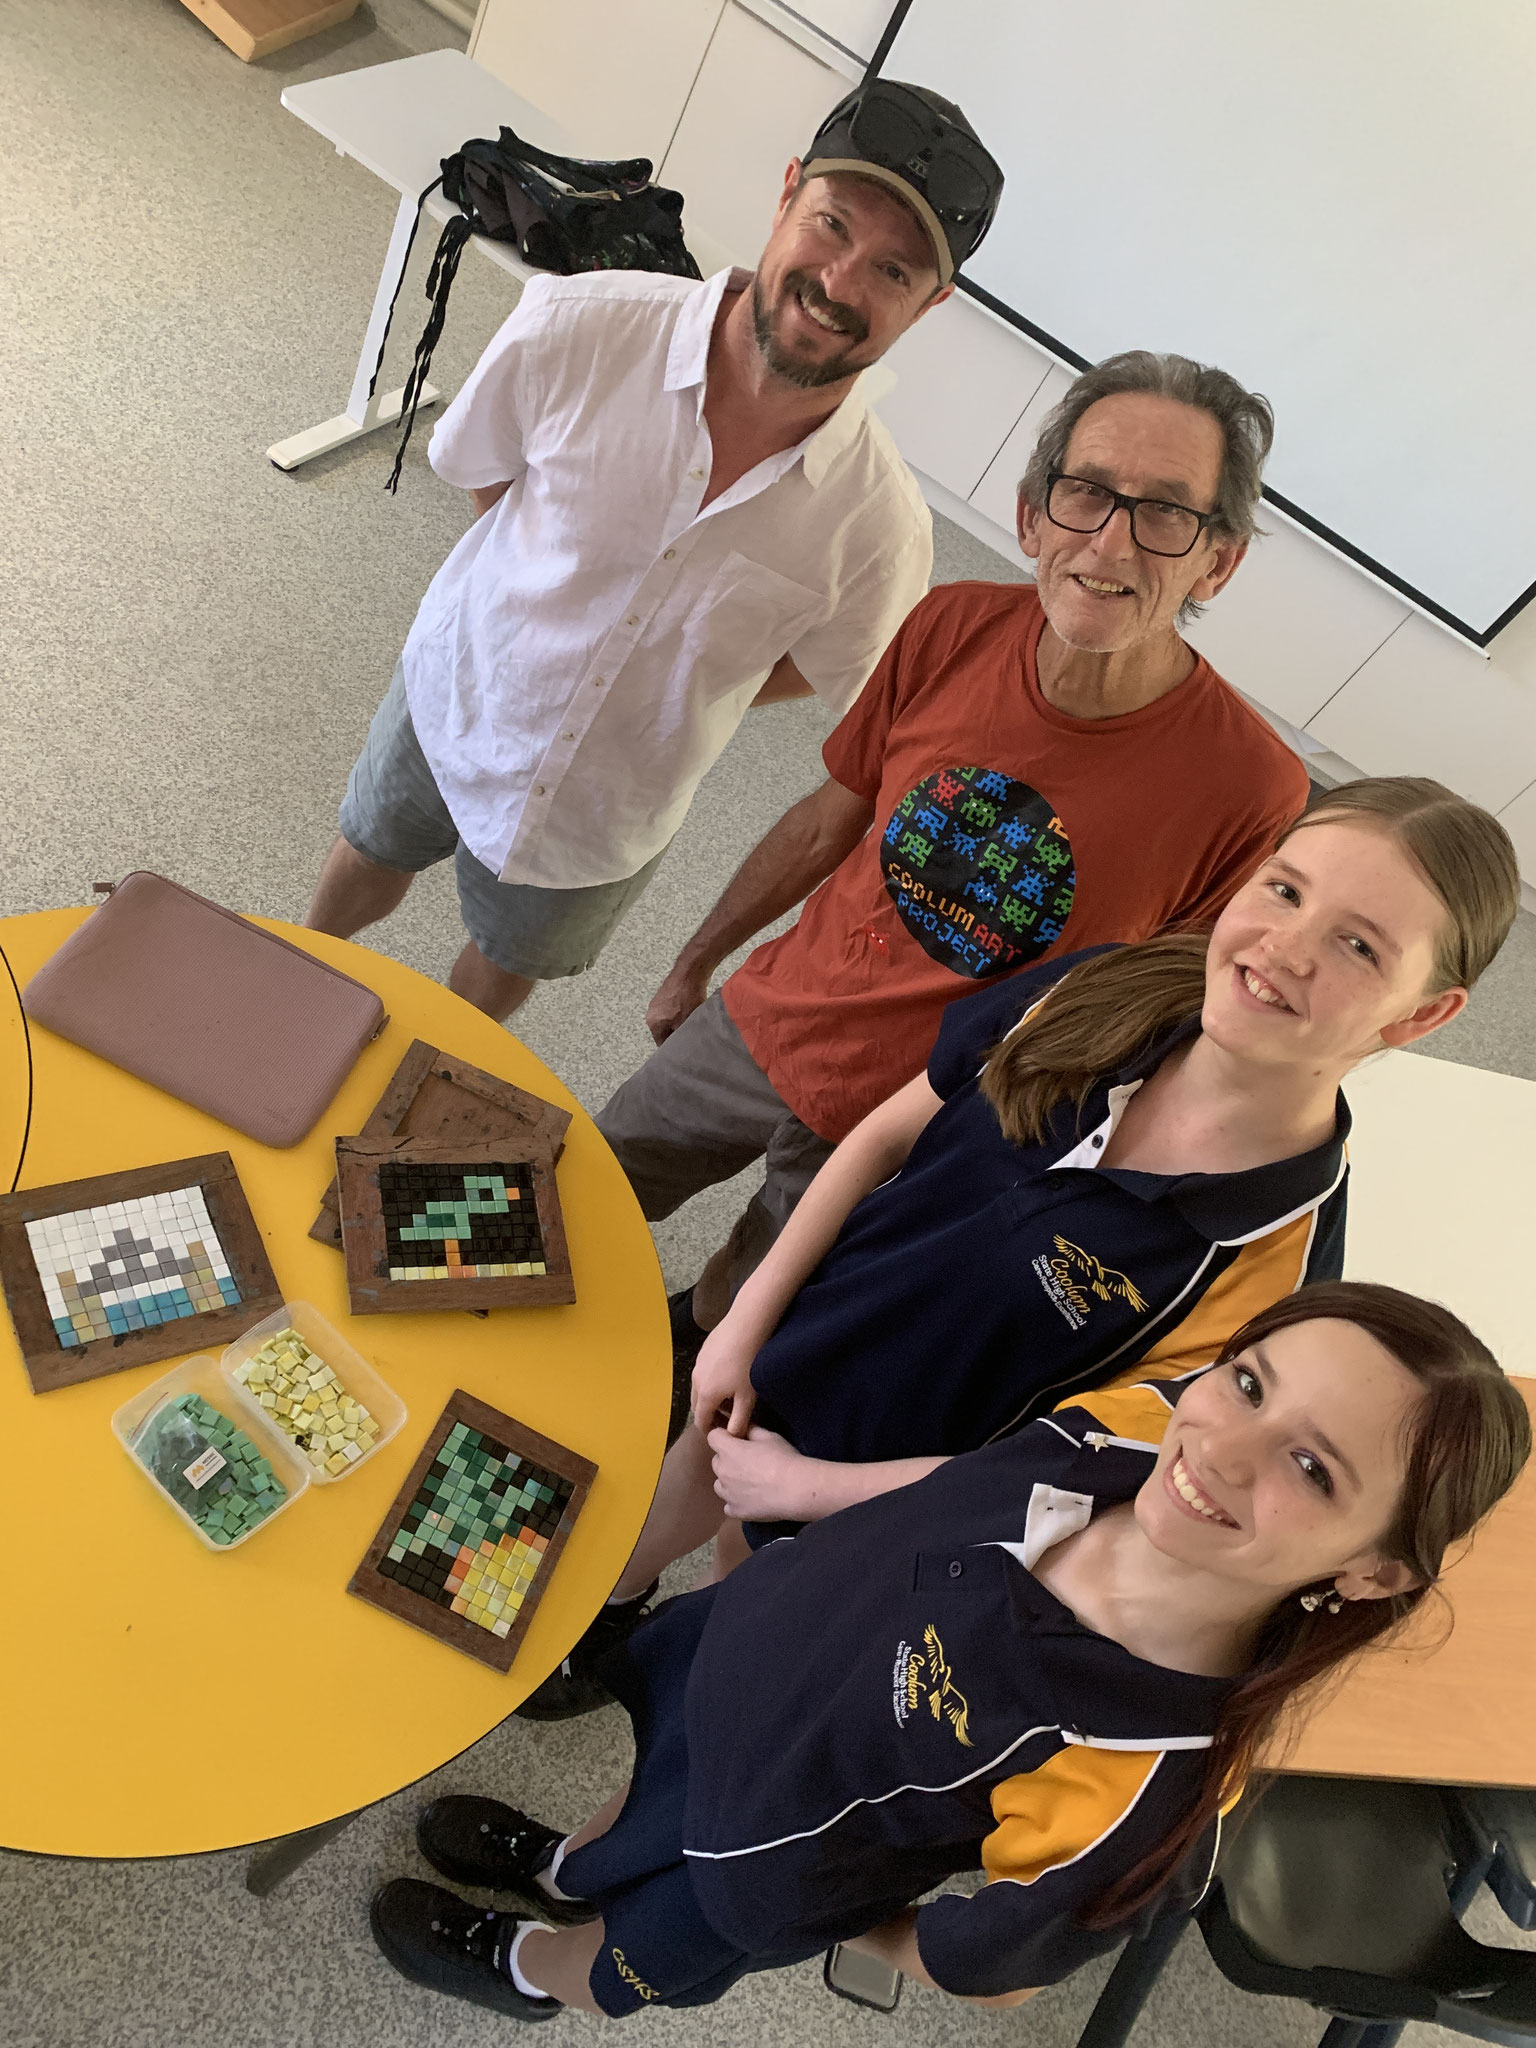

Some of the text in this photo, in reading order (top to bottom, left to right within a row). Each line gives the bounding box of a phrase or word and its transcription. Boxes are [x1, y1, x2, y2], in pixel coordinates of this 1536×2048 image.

[888, 862, 1022, 963] COOLUM ART
[897, 891, 991, 972] PROJECT
[1038, 1254, 1087, 1326] State High School
[1050, 1258, 1091, 1314] Coolum
[899, 1646, 912, 1718] State High School
[908, 1653, 927, 1710] Coolum
